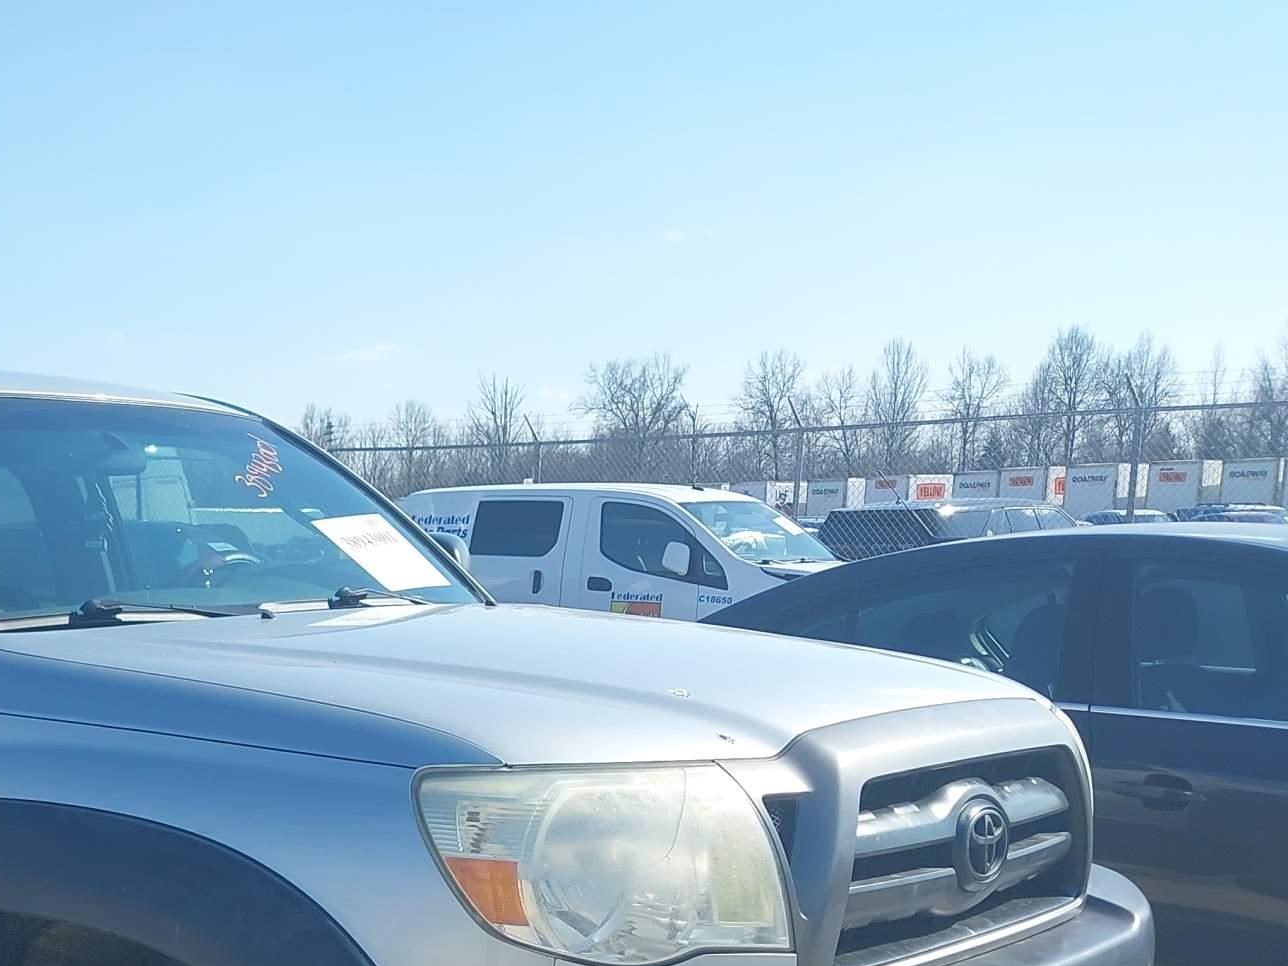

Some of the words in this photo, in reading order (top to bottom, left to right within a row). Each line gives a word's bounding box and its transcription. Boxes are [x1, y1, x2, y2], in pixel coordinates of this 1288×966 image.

[1072, 475, 1109, 483] ROADWAY
[959, 481, 991, 489] ROADWAY
[920, 486, 943, 497] YELLOW
